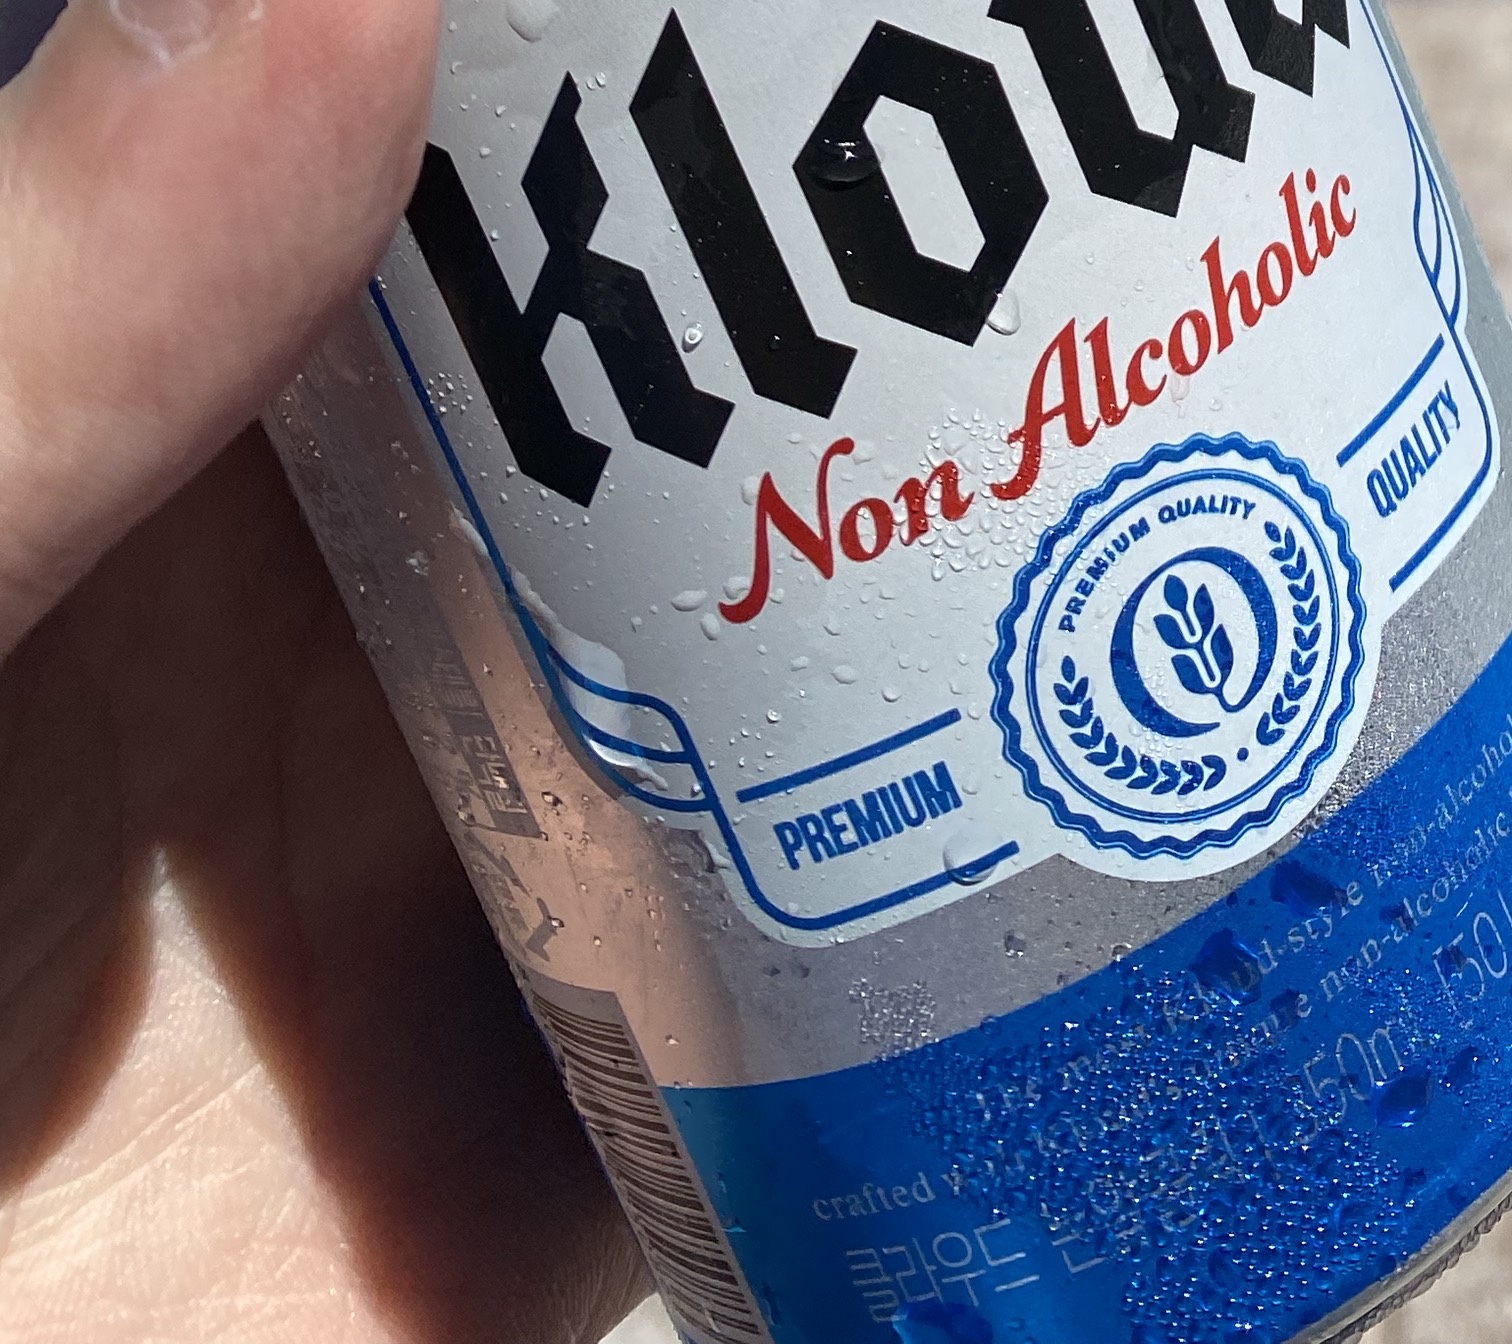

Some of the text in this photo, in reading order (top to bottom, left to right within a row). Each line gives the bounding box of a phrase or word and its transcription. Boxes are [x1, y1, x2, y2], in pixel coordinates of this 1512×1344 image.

[718, 168, 1357, 623] Non Alcoholic
[1366, 379, 1461, 518] QUALITY
[1058, 494, 1257, 633] PREMIUM QUALITY
[773, 760, 963, 871] PREMIUM
[811, 1170, 937, 1223] crafted
[846, 1217, 1040, 1323] 클라우드
